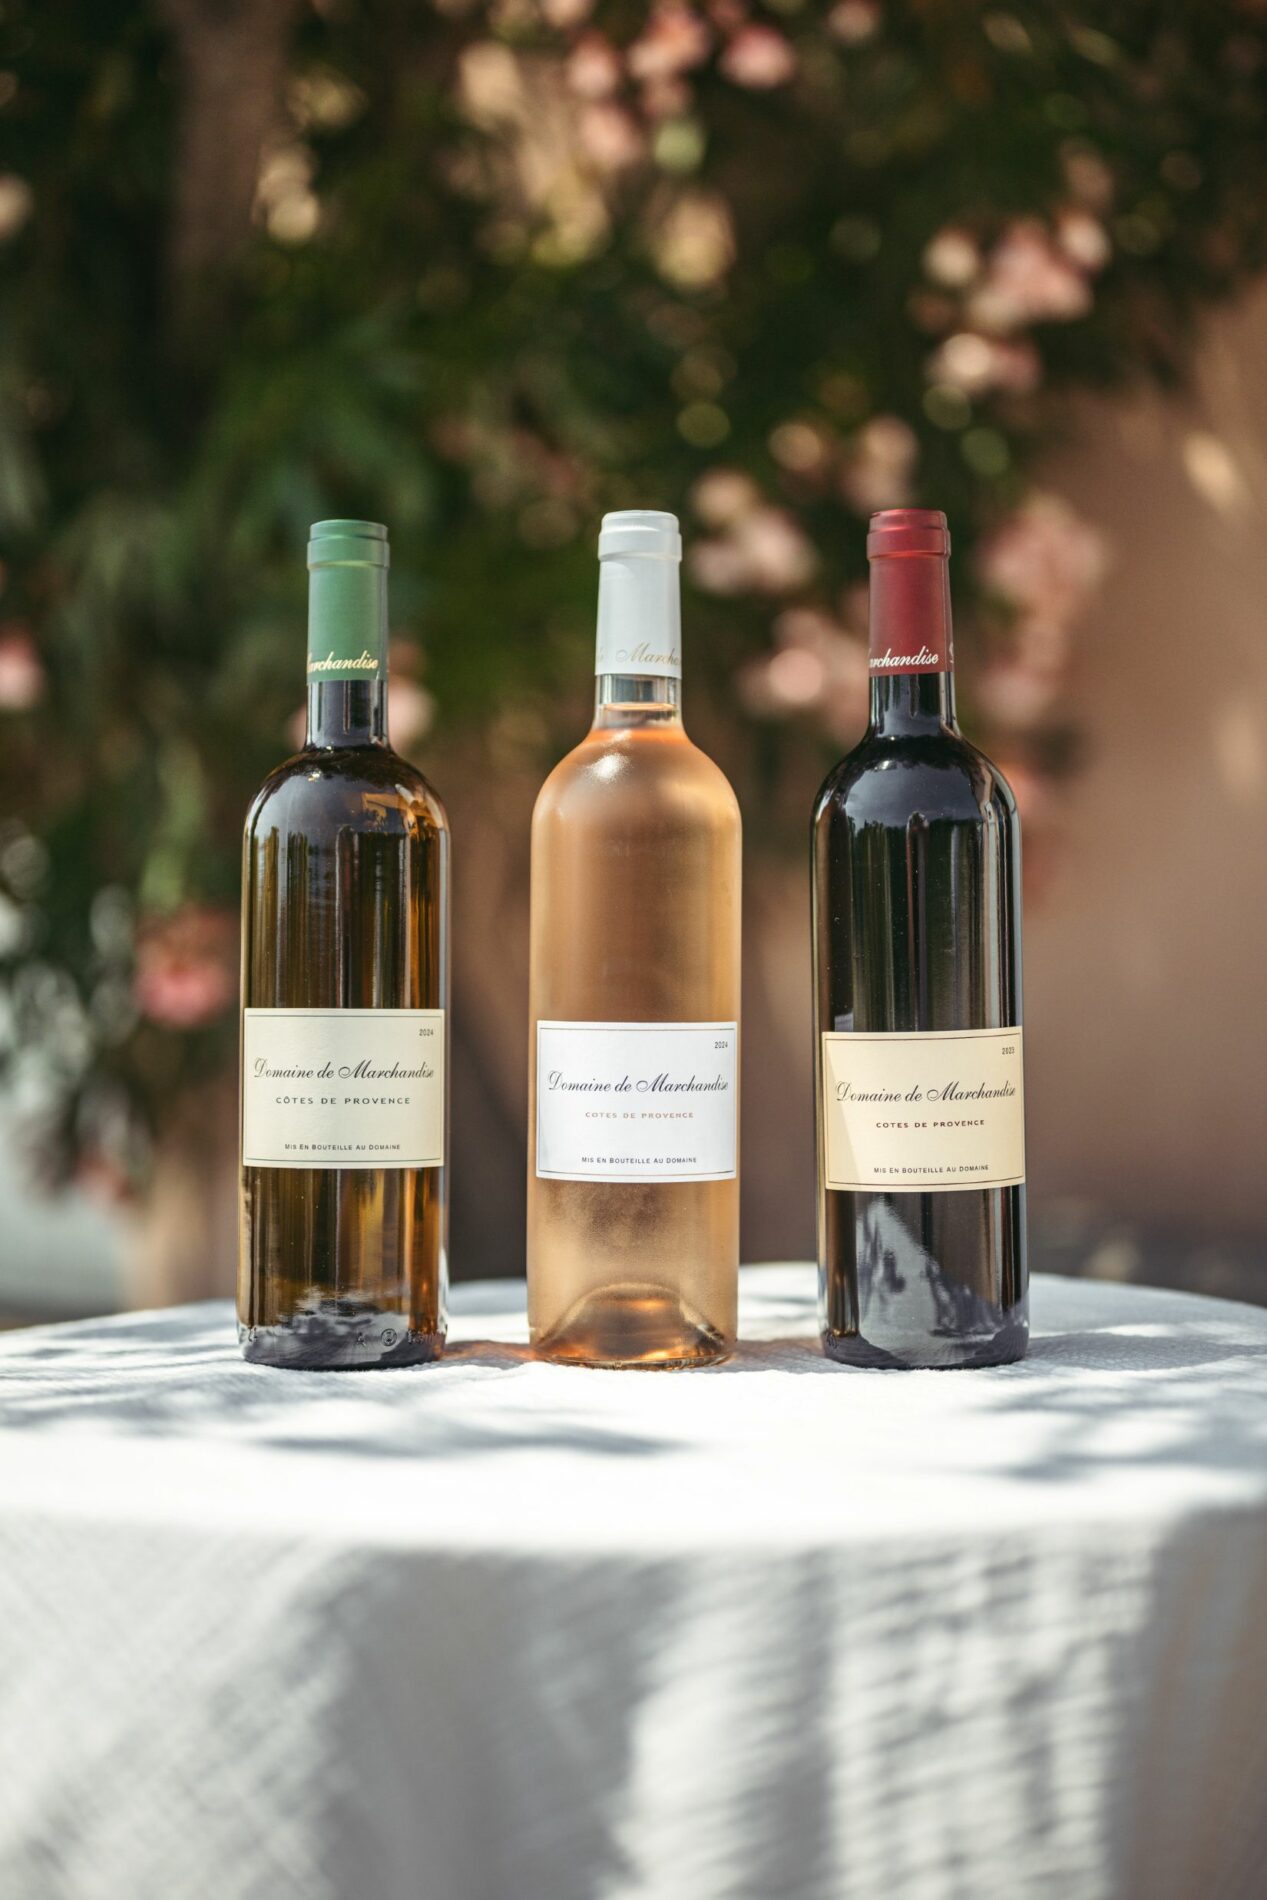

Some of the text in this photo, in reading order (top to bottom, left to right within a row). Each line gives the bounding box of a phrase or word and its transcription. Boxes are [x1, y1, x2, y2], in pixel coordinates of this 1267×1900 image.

[418, 1028, 435, 1037] 2024
[714, 1041, 729, 1049] 2024
[254, 1057, 435, 1080] Domaine de Marchandise
[548, 1070, 729, 1093] Domaine de Marchandise
[836, 1080, 1016, 1102] Domaine de Marchandise
[275, 1096, 411, 1105] CÔTES DE PROVENCE
[933, 1119, 985, 1128] PROVENCE
[368, 1143, 401, 1151] DOMAINE
